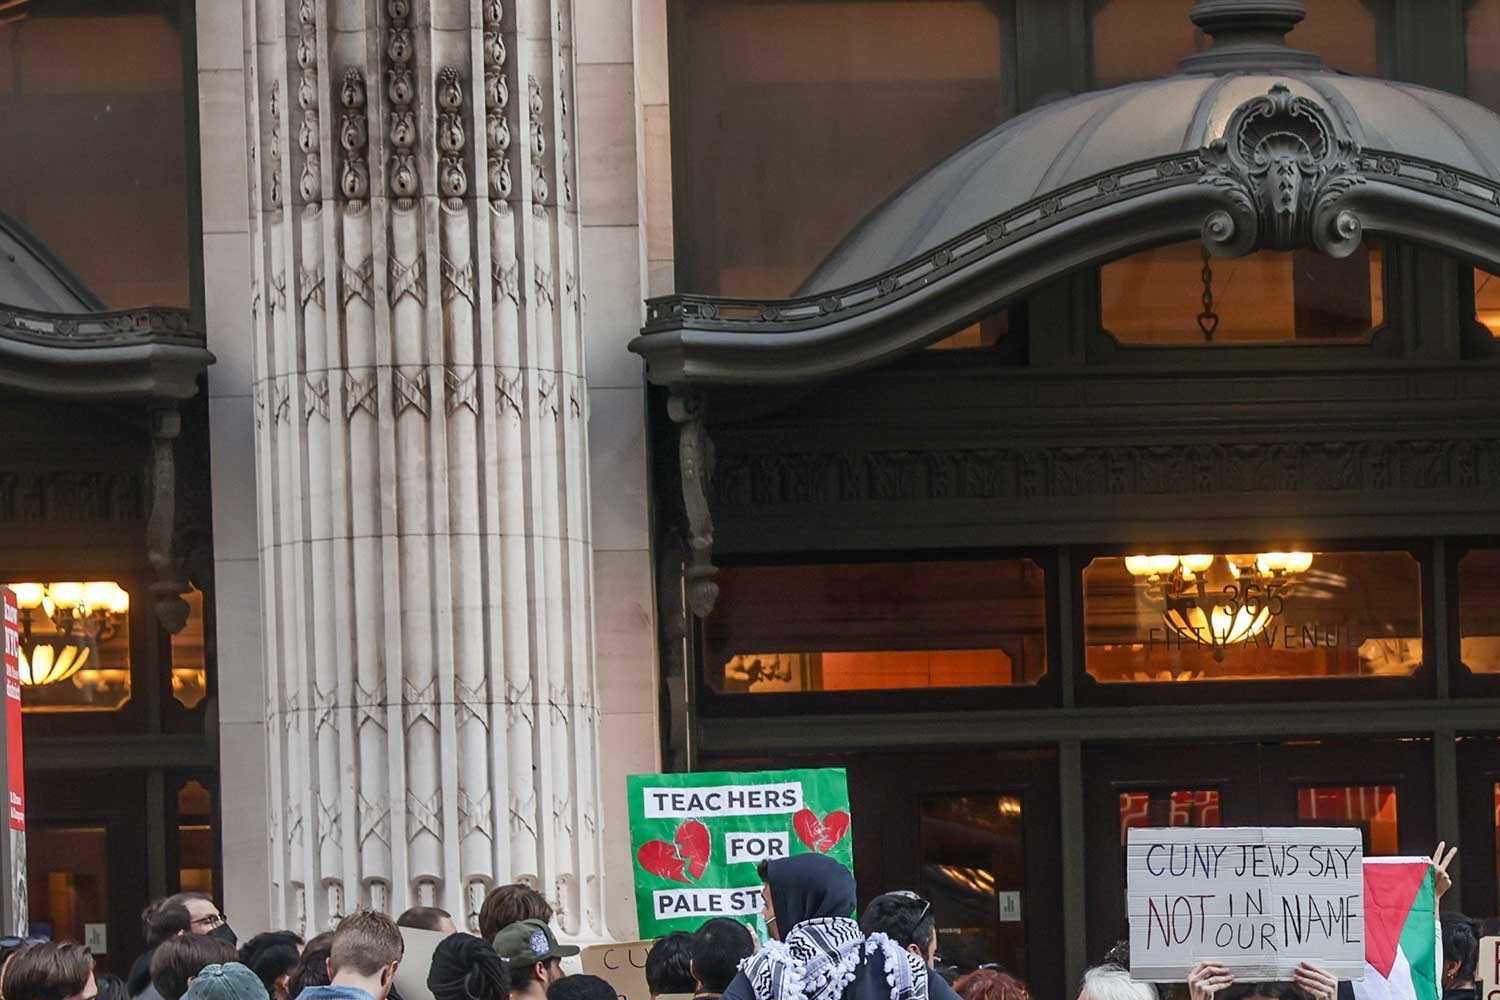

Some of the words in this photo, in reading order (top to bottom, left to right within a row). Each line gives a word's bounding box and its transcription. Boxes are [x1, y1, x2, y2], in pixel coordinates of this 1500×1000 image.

[1223, 584, 1285, 616] 365
[1149, 626, 1228, 652] FIFTH
[654, 789, 797, 812] TEACHERS
[731, 838, 784, 857] FOR
[1147, 843, 1228, 879] CUNY
[1234, 844, 1300, 878] JEWS
[1308, 845, 1357, 879] SAY
[659, 890, 762, 914] PALEST
[1229, 888, 1263, 918] IN
[1147, 894, 1217, 950] NOT
[1282, 894, 1362, 948] NAME
[1215, 922, 1277, 951] OUR
